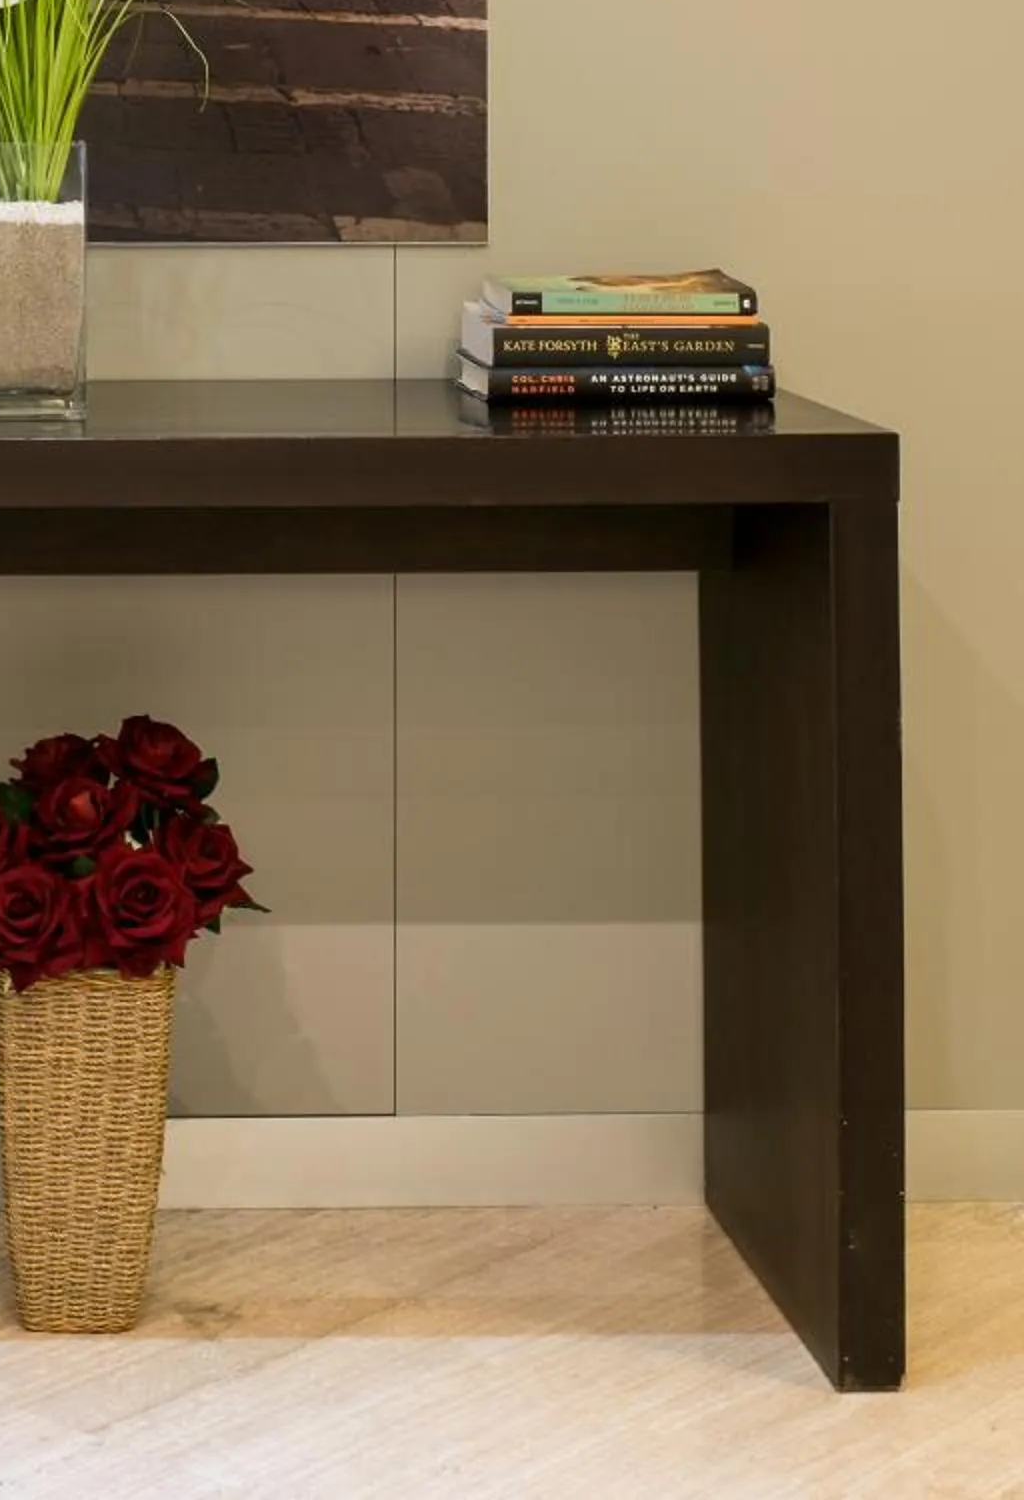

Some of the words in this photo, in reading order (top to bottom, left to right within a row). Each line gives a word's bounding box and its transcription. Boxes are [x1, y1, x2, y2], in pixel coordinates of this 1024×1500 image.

[503, 340, 537, 351] KATE
[539, 340, 597, 351] FORSYTH
[607, 334, 669, 359] BEAST'S
[673, 340, 735, 351] GARDEN
[591, 374, 607, 383] AN
[612, 373, 695, 383] ASTRONAUT'S
[699, 373, 737, 383] GUIDE
[610, 385, 625, 393] TO
[631, 385, 656, 393] LIFE
[659, 385, 676, 393] ON
[679, 385, 718, 393] EARTH
